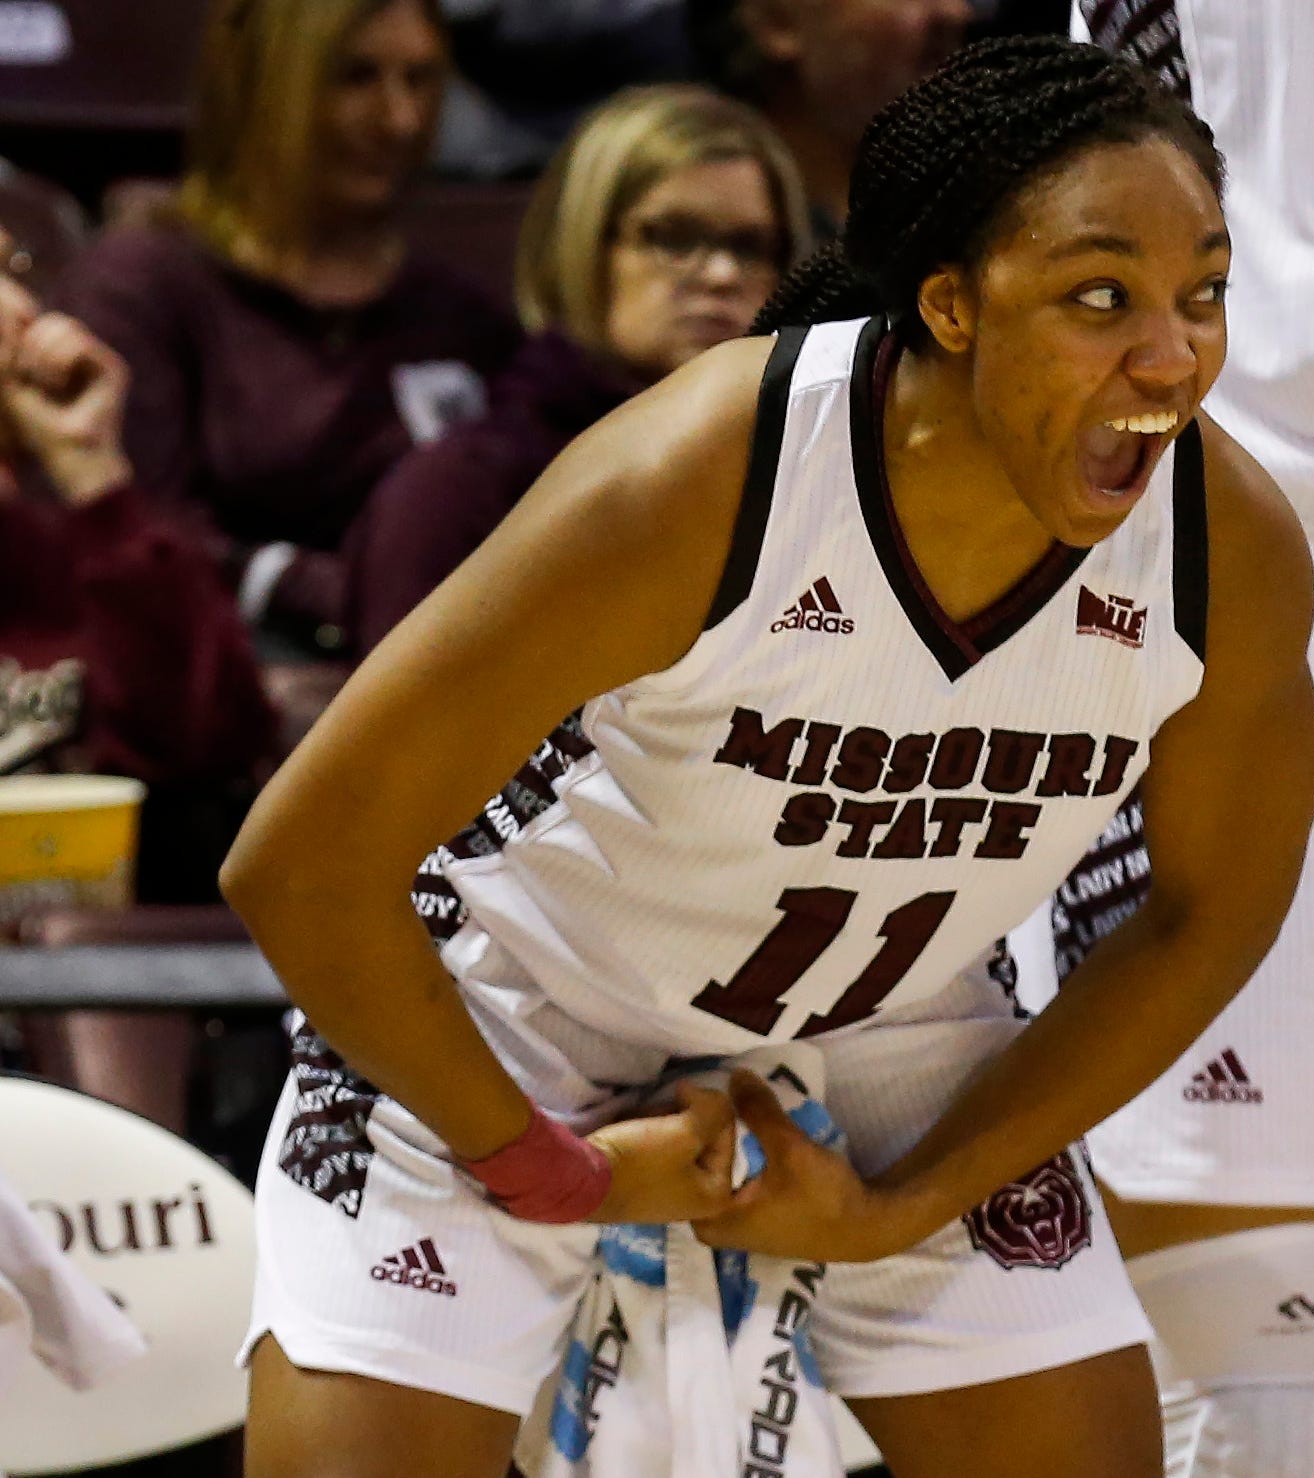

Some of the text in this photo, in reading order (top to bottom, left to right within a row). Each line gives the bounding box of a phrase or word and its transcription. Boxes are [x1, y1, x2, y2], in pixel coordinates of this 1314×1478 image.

[770, 610, 855, 635] adidas
[713, 705, 1139, 799] MISSOURI
[773, 791, 1043, 861] STATE
[690, 886, 958, 1041] 11
[28, 1182, 216, 1258] ouri
